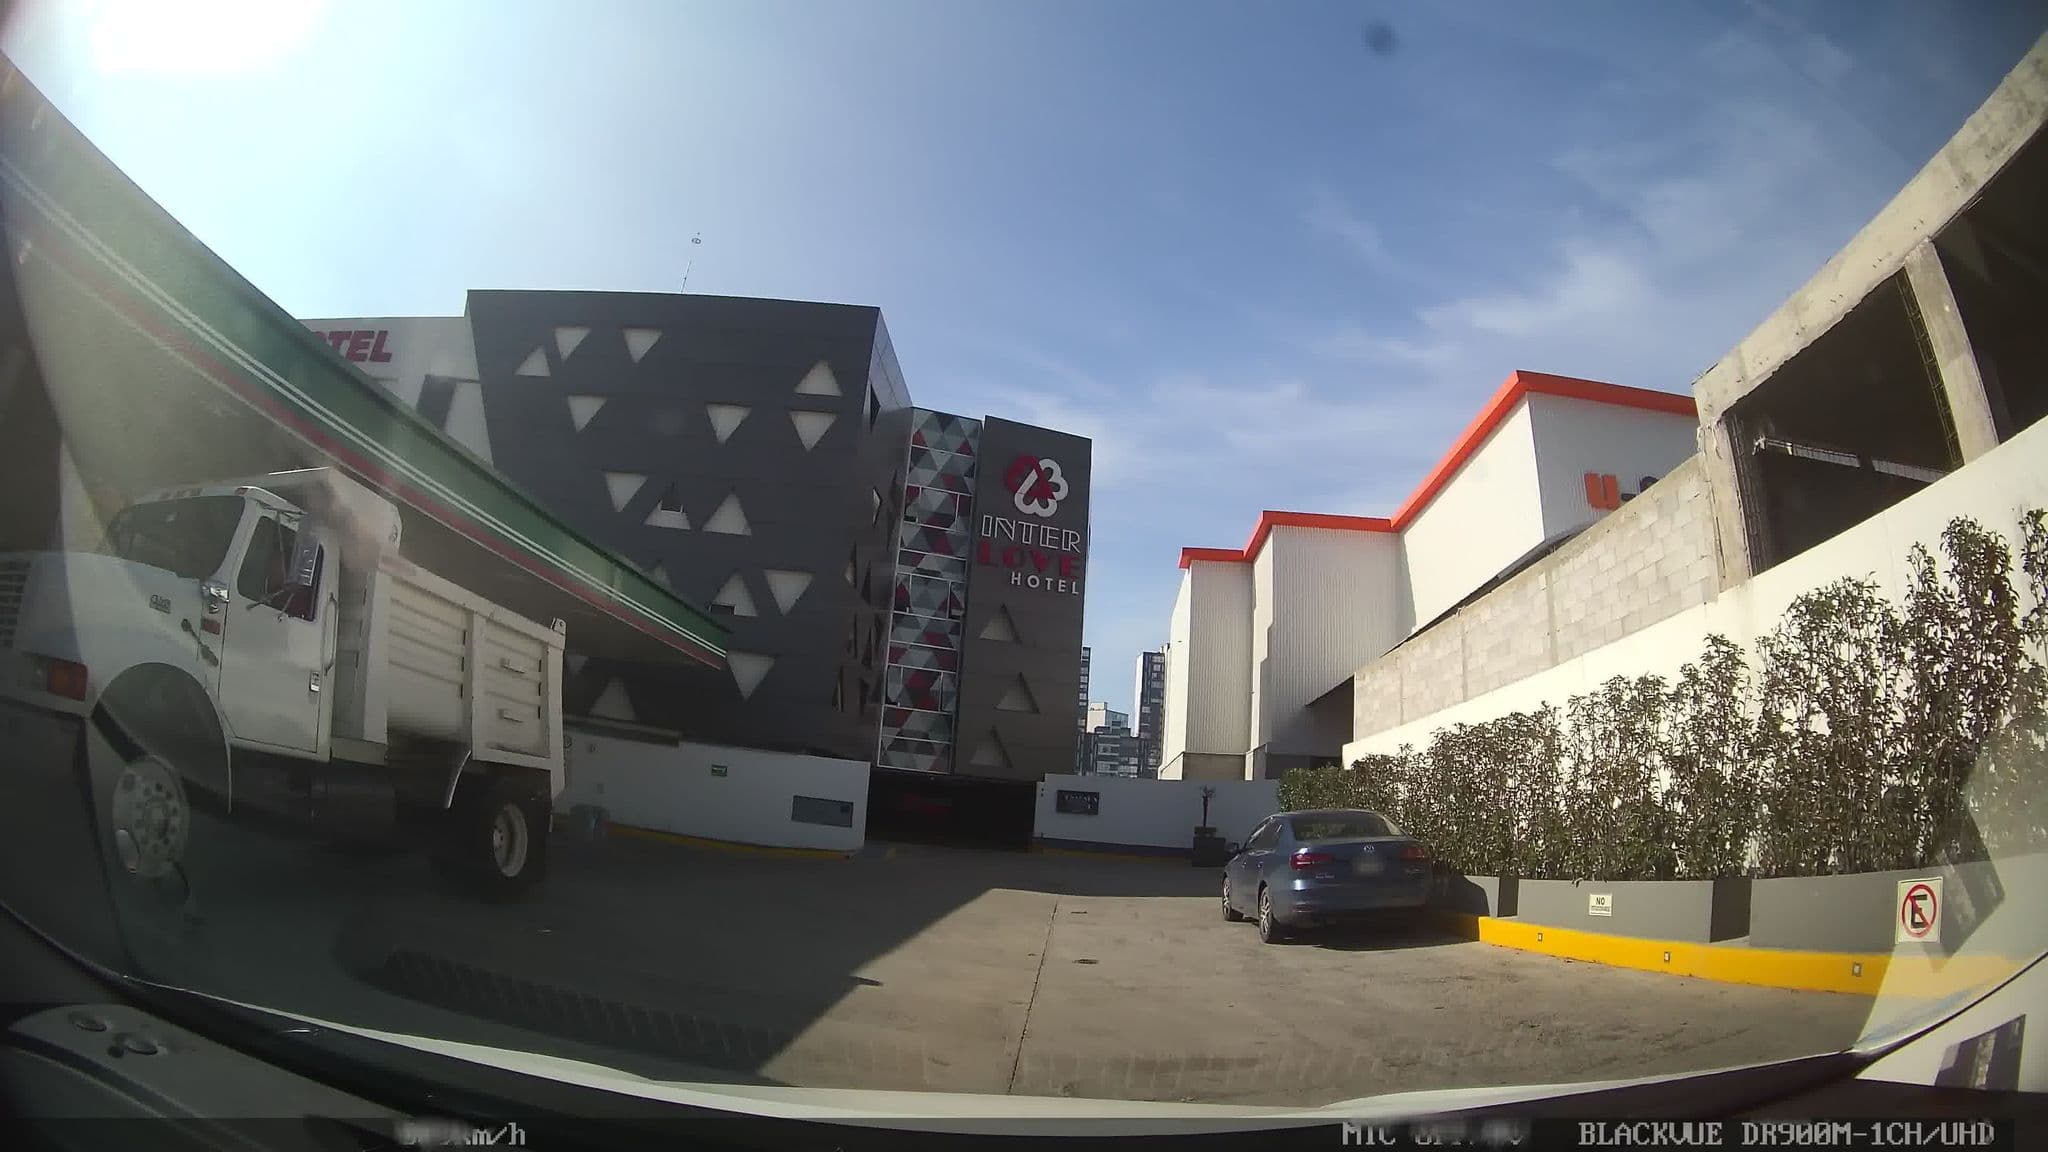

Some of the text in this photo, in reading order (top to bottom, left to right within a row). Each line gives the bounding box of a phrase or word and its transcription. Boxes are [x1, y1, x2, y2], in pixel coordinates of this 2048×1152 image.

[314, 330, 392, 363] TEL
[981, 514, 1081, 554] INTER
[977, 539, 1081, 582] LOVE
[1010, 571, 1080, 595] HOTEL
[1595, 896, 1606, 906] NO
